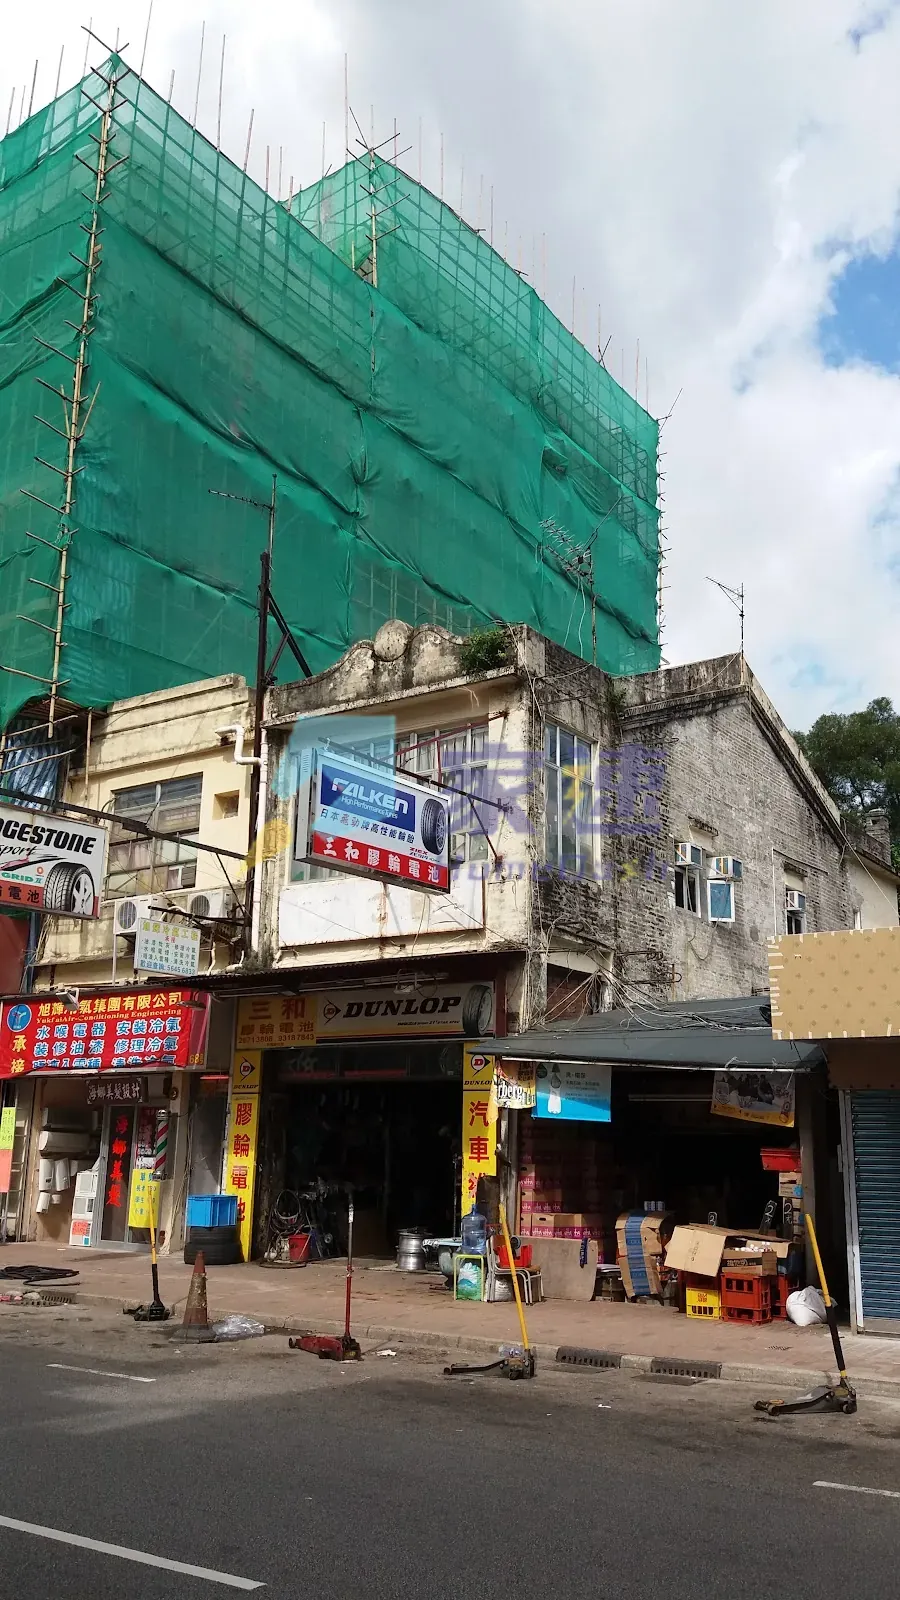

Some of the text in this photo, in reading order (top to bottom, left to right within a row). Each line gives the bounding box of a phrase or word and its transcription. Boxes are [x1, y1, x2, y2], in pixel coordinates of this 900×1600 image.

[323, 836, 439, 882] 三和膠輪電池
[0, 885, 40, 904] 電池
[38, 992, 182, 1017] 旭輝氣集團有限公司
[131, 1008, 182, 1019] Engineering
[248, 997, 306, 1020] 三和
[343, 996, 462, 1019] DUNLOP
[36, 1017, 182, 1040] 水喉電器 安裝冷氣
[240, 1021, 315, 1036] 膠輪電池
[10, 1035, 27, 1074] 承接
[34, 1035, 180, 1057] 裝修油漆 修理冷氣
